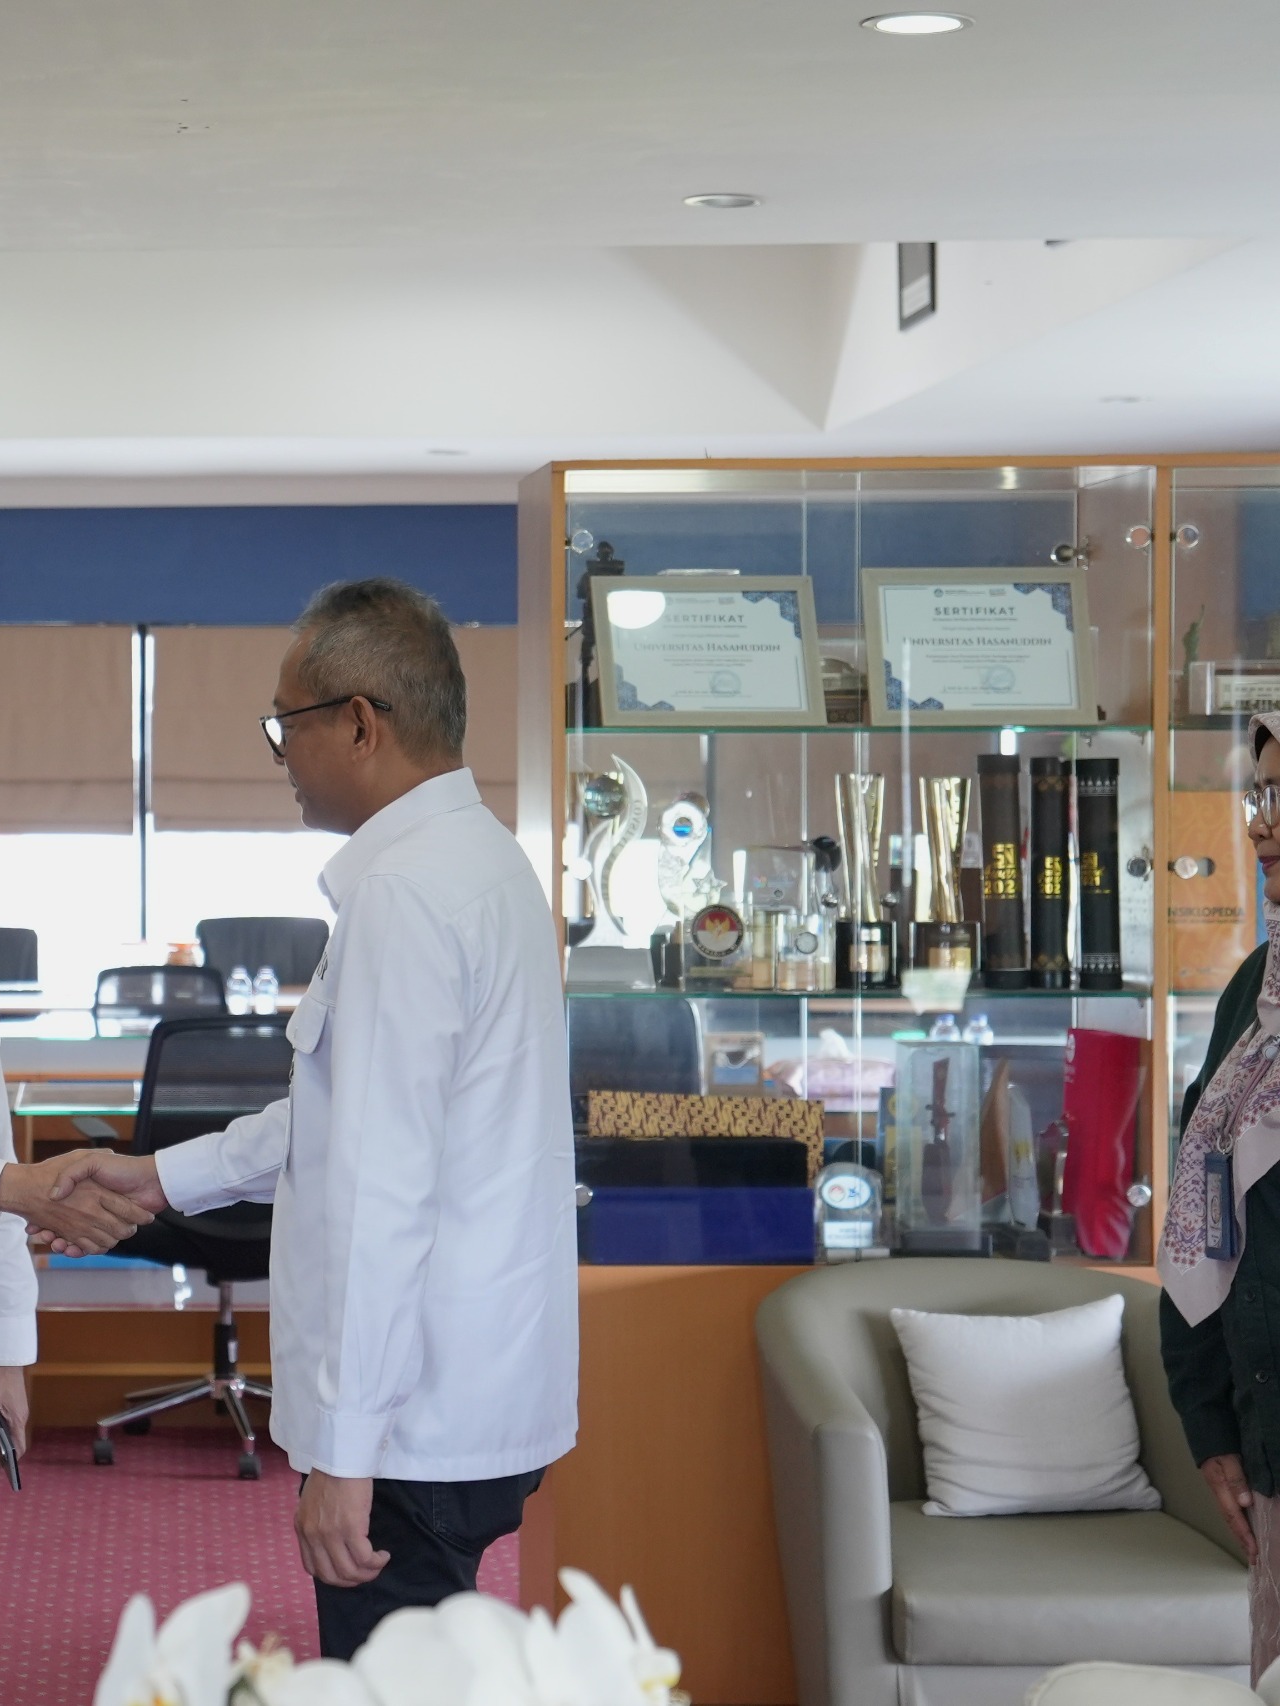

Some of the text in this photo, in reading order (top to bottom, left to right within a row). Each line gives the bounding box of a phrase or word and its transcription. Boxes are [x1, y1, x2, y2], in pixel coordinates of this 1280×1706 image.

[934, 606, 1016, 616] SERTIFIKAT
[665, 614, 745, 623] SERTIFIKAT
[977, 637, 1052, 646] HASANUDDIN
[707, 643, 781, 652] HASANUDDIN
